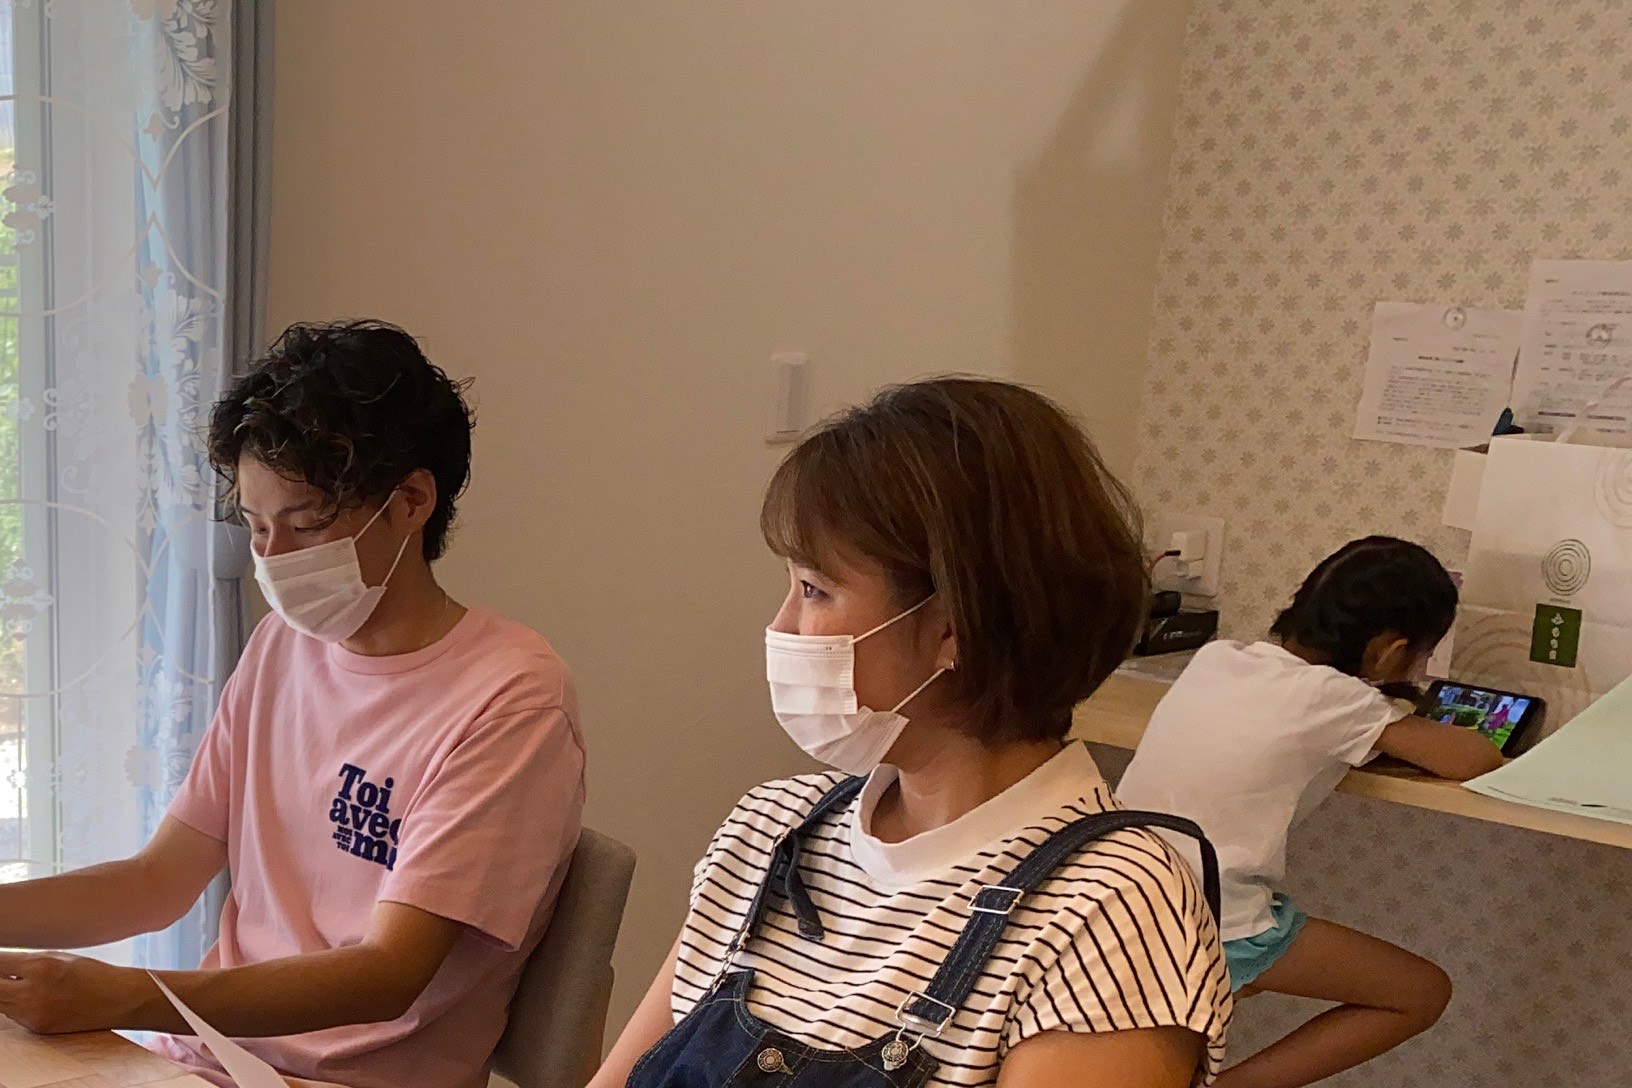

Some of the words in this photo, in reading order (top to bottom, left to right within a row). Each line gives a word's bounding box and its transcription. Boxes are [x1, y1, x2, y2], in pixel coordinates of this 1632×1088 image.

[338, 763, 394, 814] Toi
[332, 832, 352, 844] AVEC
[336, 841, 350, 852] TOI
